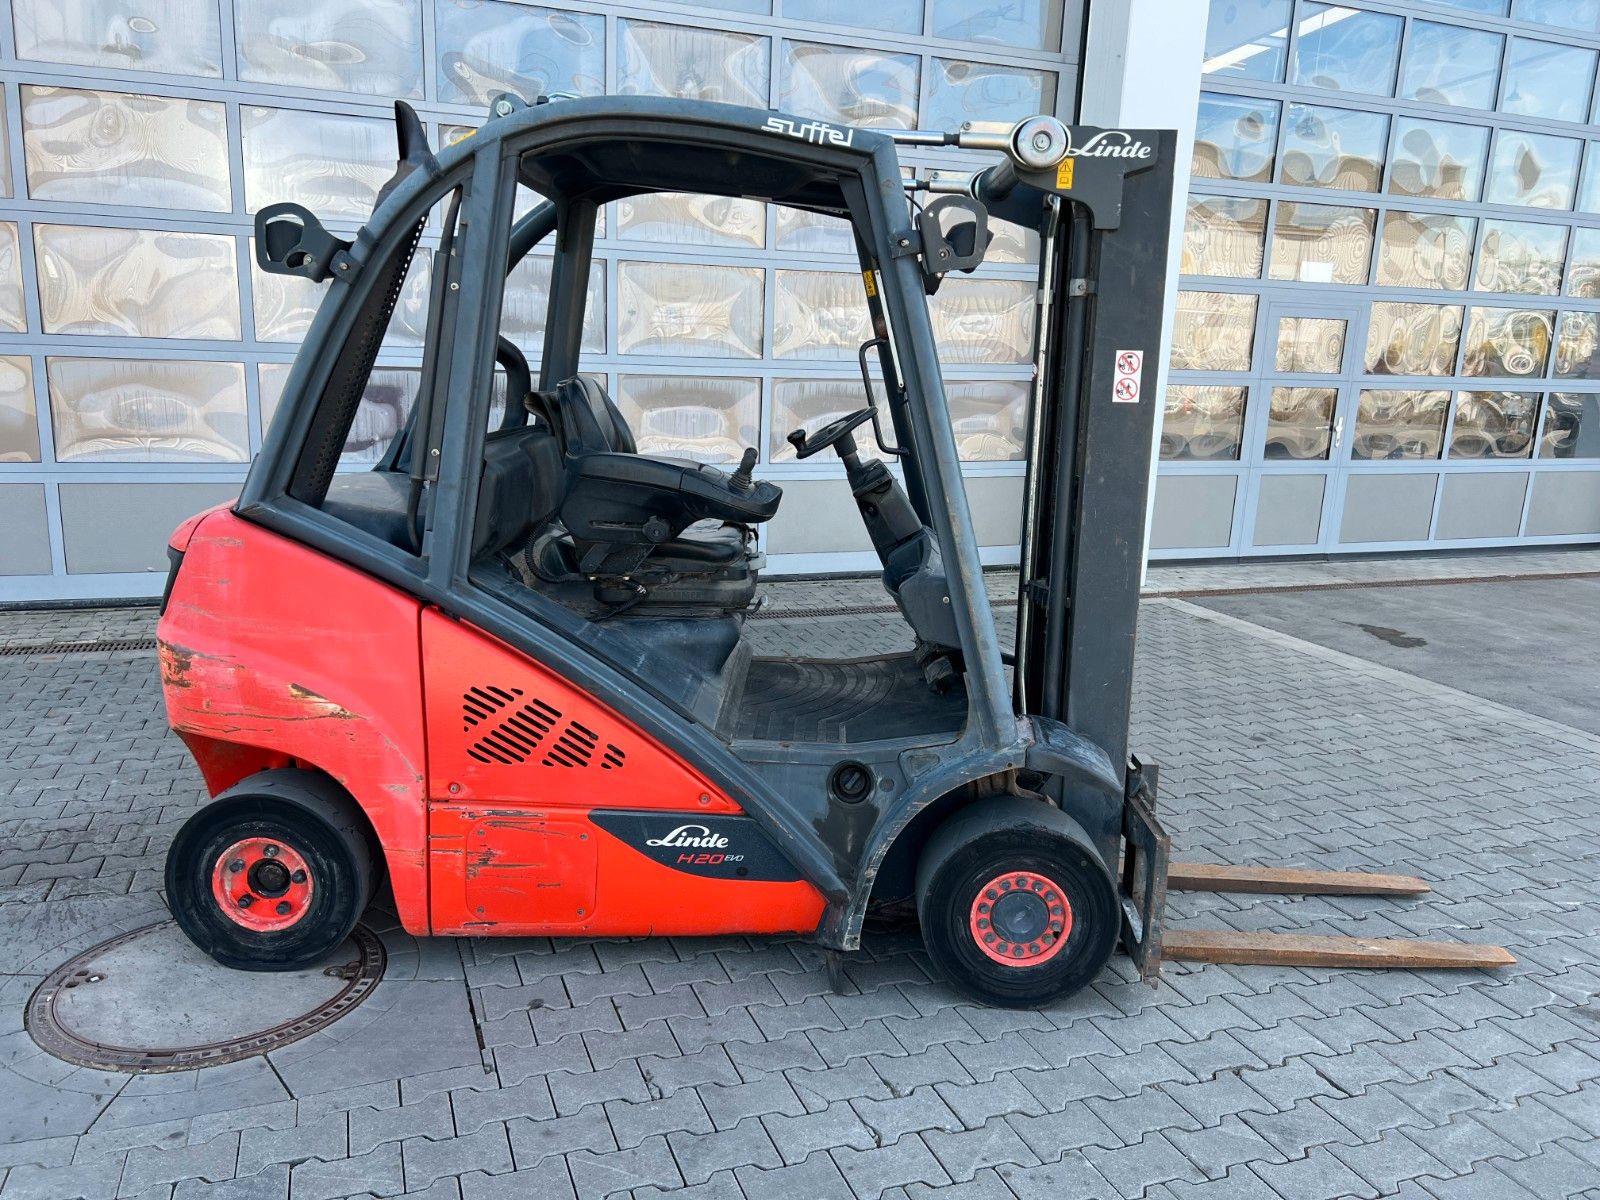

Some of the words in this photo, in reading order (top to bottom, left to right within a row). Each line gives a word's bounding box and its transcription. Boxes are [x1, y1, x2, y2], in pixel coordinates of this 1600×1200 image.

[761, 116, 853, 147] suffel
[1067, 131, 1152, 159] Linde
[646, 824, 729, 848] Linde
